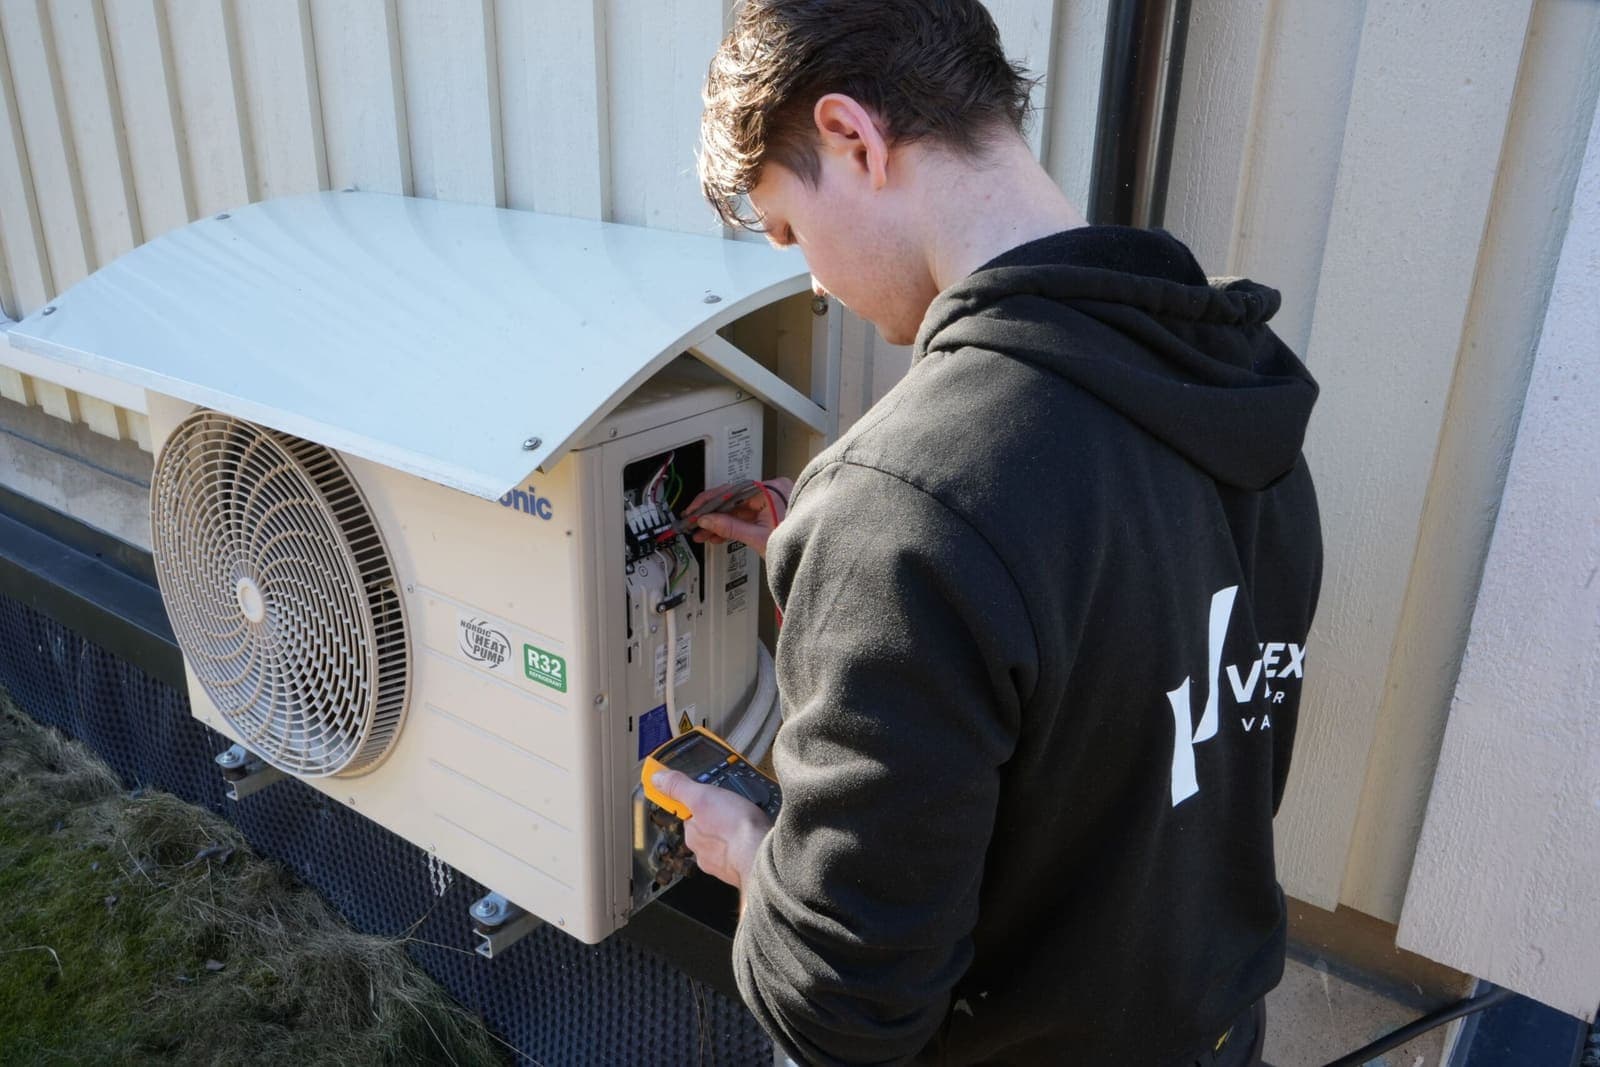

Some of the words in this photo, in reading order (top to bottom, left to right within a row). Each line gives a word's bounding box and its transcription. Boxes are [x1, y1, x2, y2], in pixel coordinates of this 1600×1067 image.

[460, 620, 492, 638] NORDIC
[475, 635, 507, 655] HEAT
[473, 645, 505, 666] PUMP
[528, 649, 562, 679] R32
